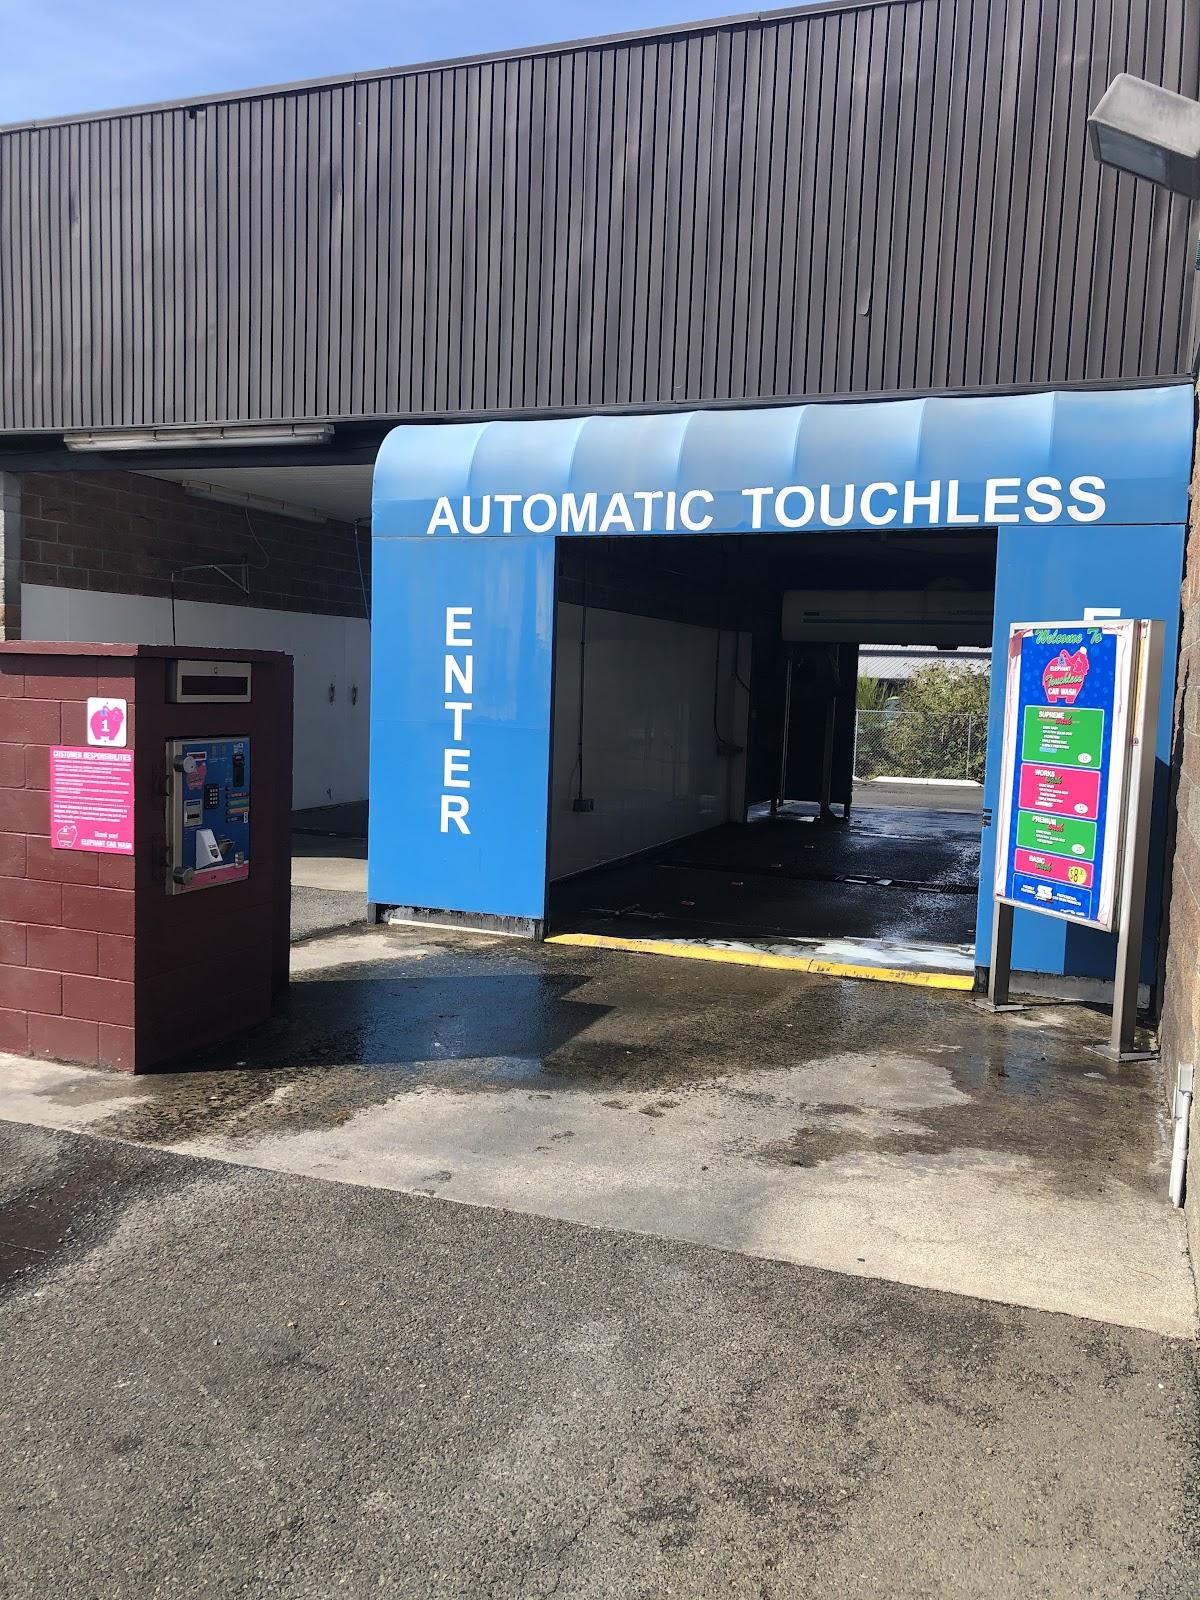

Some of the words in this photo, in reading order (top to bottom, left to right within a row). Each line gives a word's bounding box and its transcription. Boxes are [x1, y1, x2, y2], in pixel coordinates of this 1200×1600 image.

[426, 488, 714, 536] AUTOMATIC
[741, 475, 1107, 531] TOUCHLESS
[1035, 629, 1083, 644] Welcome
[1087, 629, 1102, 644] To
[1048, 687, 1059, 695] CAR
[1061, 688, 1077, 696] WASH
[1038, 710, 1065, 719] SUPREME
[100, 719, 110, 732] 1
[439, 606, 474, 836] ENTER
[53, 750, 83, 759] CUSTOMER
[1035, 769, 1056, 778] WORKS
[1032, 815, 1057, 825] PREMIUM
[80, 838, 106, 847] ELEPHANT
[106, 840, 117, 848] CAR
[117, 841, 132, 850] WASH
[1029, 855, 1046, 864] BASIC
